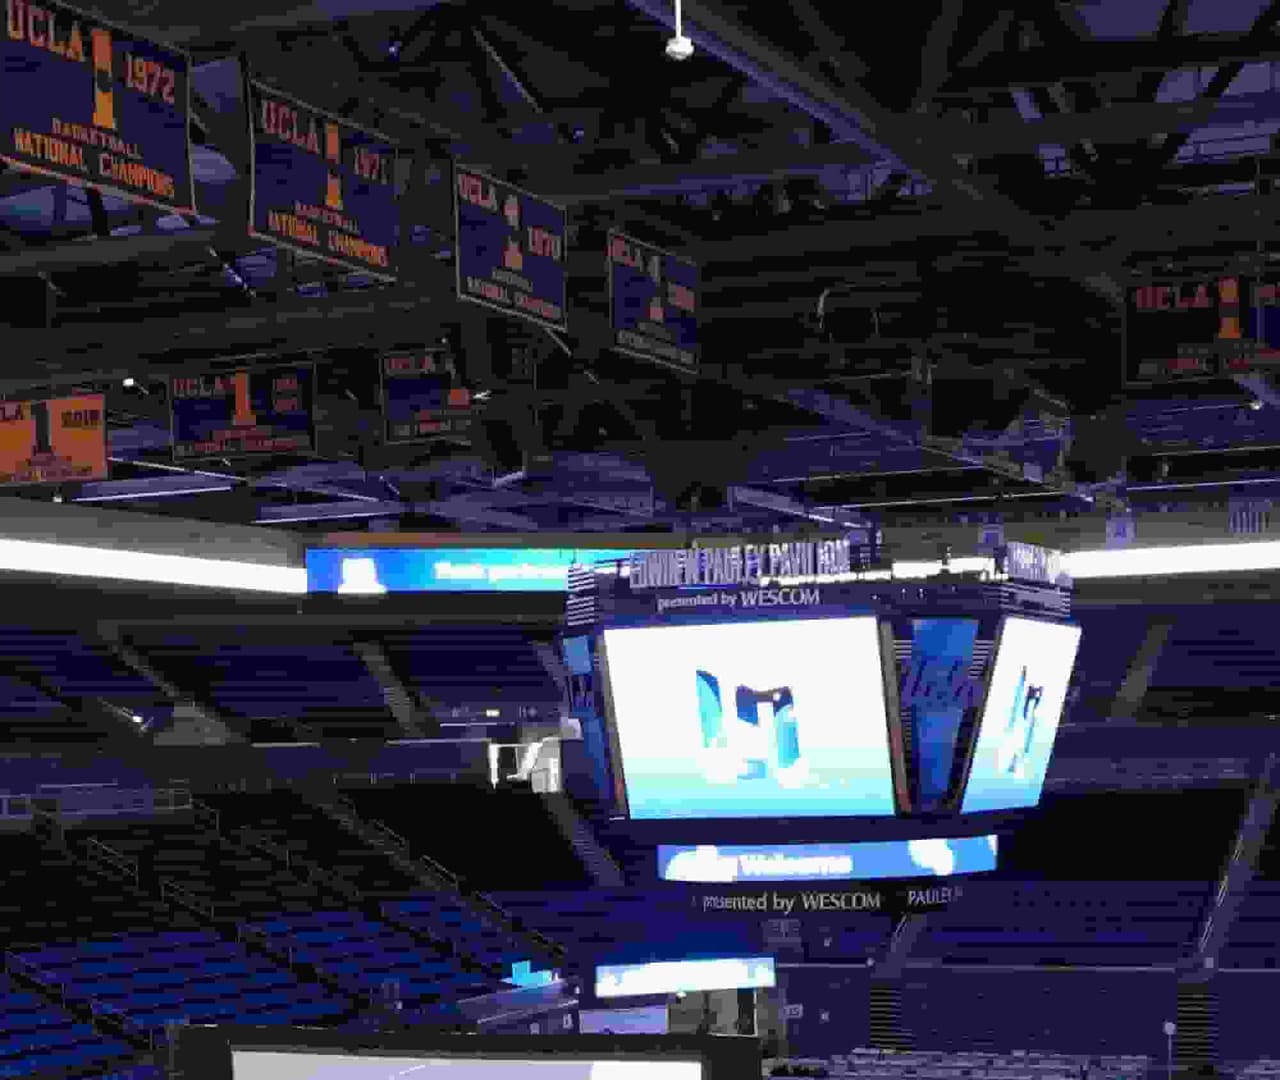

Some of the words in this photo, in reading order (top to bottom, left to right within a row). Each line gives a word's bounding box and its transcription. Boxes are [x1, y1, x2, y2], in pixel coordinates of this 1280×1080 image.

[7, 0, 84, 61] UCLA
[123, 51, 174, 104] 1972
[11, 127, 84, 168] NATIONAL
[261, 99, 318, 154] UCLA
[657, 591, 717, 612] presented
[720, 589, 737, 607] by
[739, 588, 820, 606] WESCOM
[702, 891, 767, 912] presented
[772, 891, 795, 914] by
[799, 890, 881, 910] WESCOM
